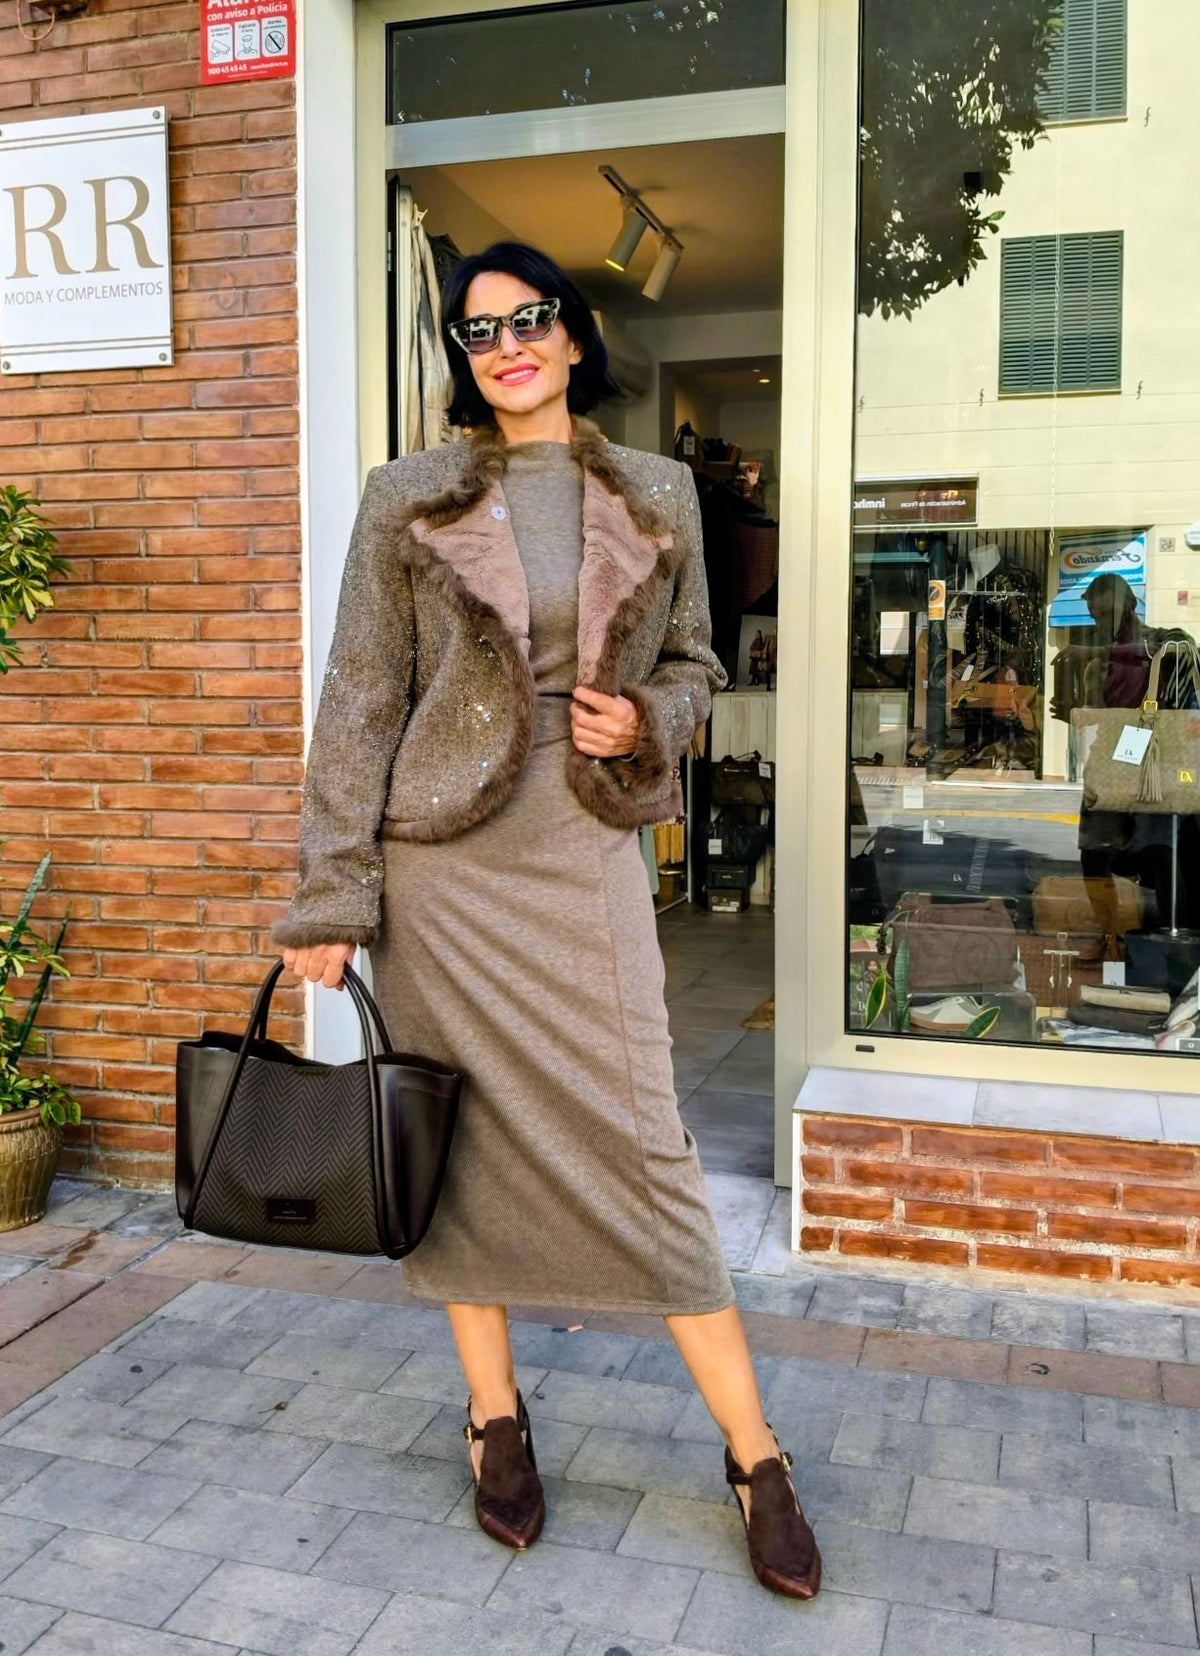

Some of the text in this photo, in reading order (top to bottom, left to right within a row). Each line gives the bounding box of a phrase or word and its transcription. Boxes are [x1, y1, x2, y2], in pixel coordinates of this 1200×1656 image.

[207, 12, 223, 21] con
[224, 8, 248, 19] aviso
[4, 281, 163, 306] MODA Y COMPLEMENTOS
